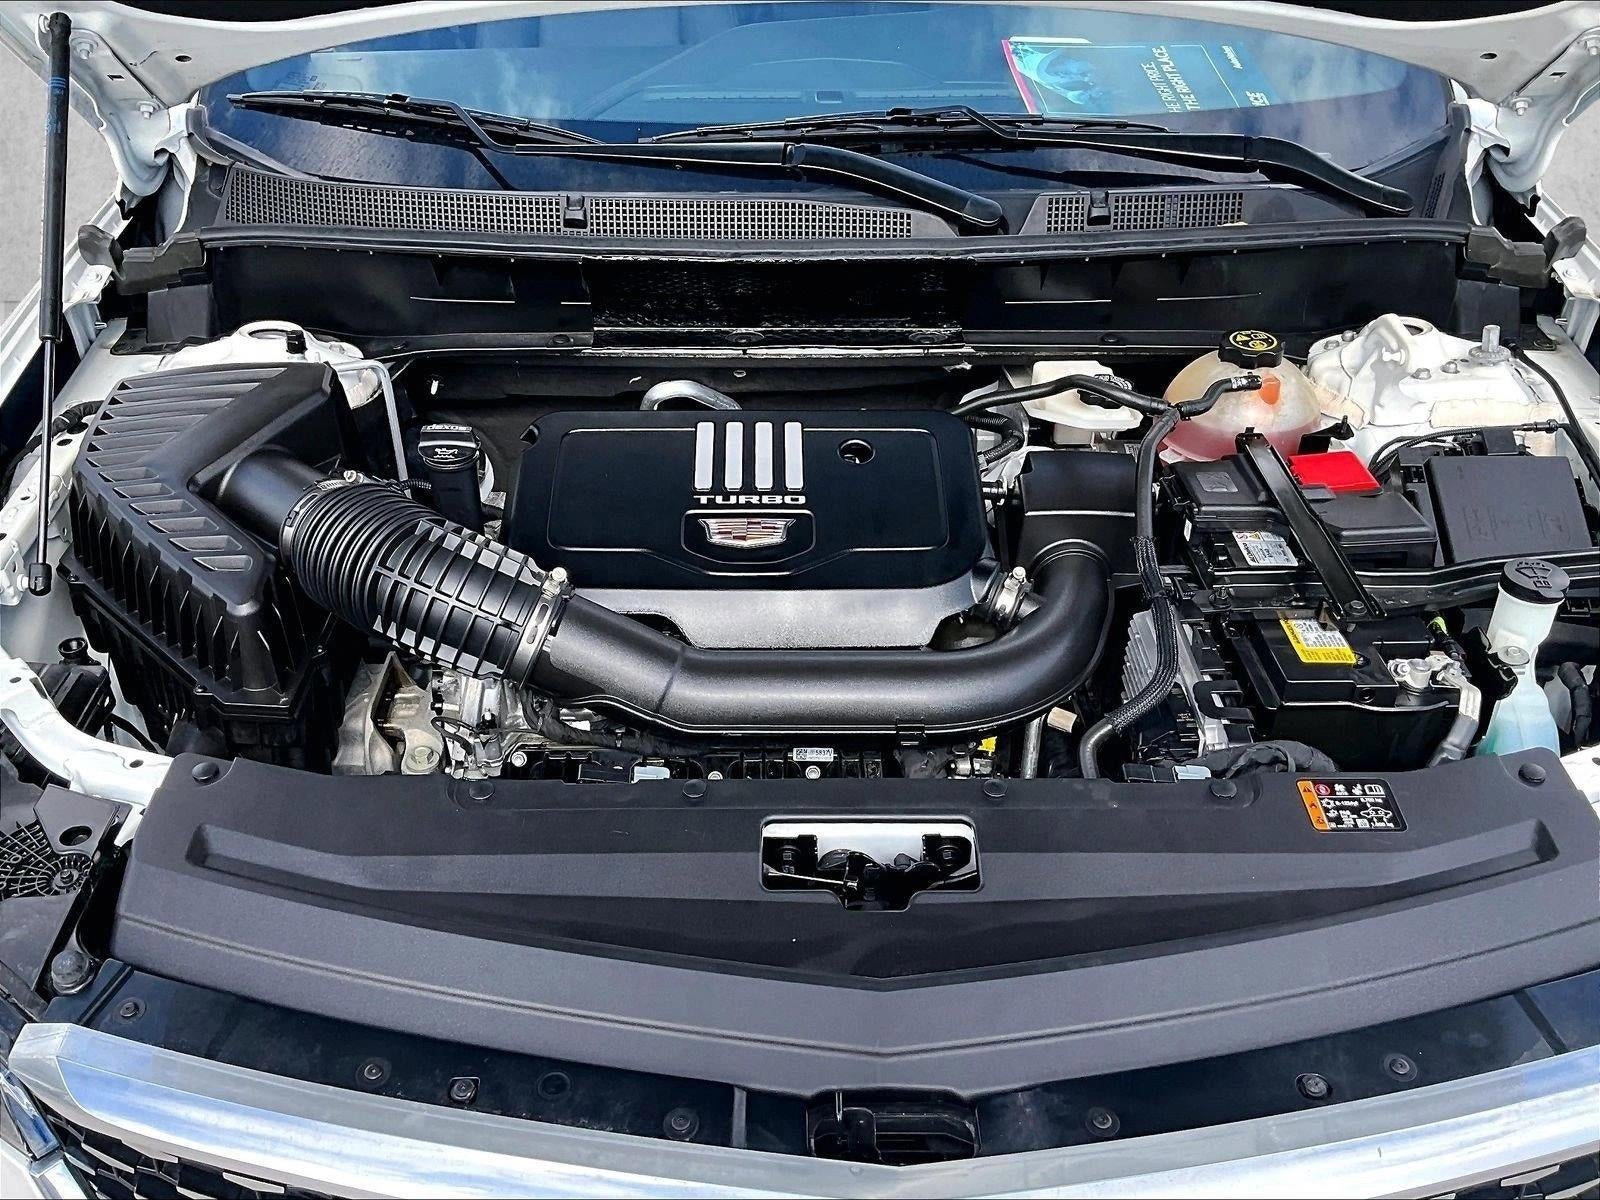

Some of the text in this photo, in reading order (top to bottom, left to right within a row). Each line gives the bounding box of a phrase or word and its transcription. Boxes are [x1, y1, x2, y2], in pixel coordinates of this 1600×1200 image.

[1141, 62, 1164, 81] PRICE
[1152, 82, 1177, 101] RIGHT
[1166, 73, 1192, 93] RIGHT
[1180, 94, 1201, 111] THE
[693, 495, 806, 504] TURBO
